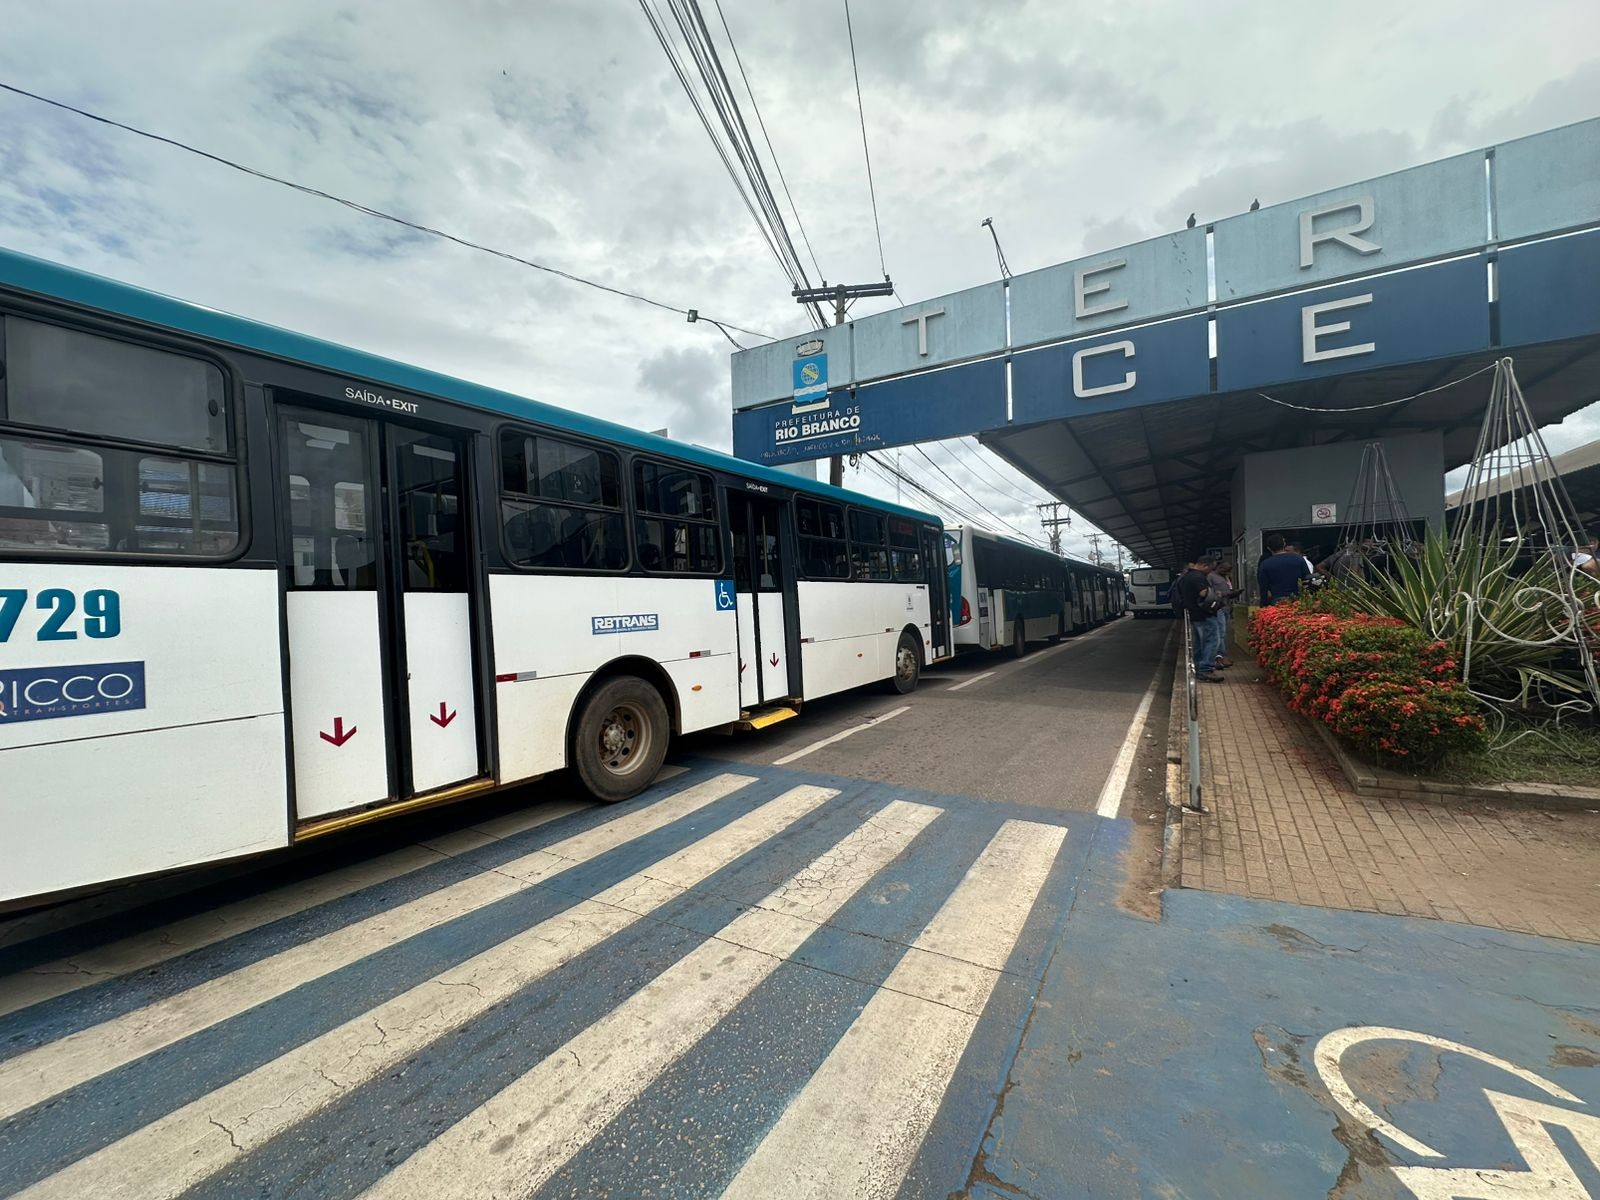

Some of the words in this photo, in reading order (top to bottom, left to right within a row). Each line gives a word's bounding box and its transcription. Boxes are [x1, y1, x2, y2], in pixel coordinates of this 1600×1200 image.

[775, 410, 840, 428] PREFEITURA
[846, 406, 860, 415] DE
[775, 427, 798, 440] RIO
[802, 415, 860, 436] BRANCO
[594, 615, 657, 629] RBTRANS
[14, 699, 130, 716] TRANSPORTES
